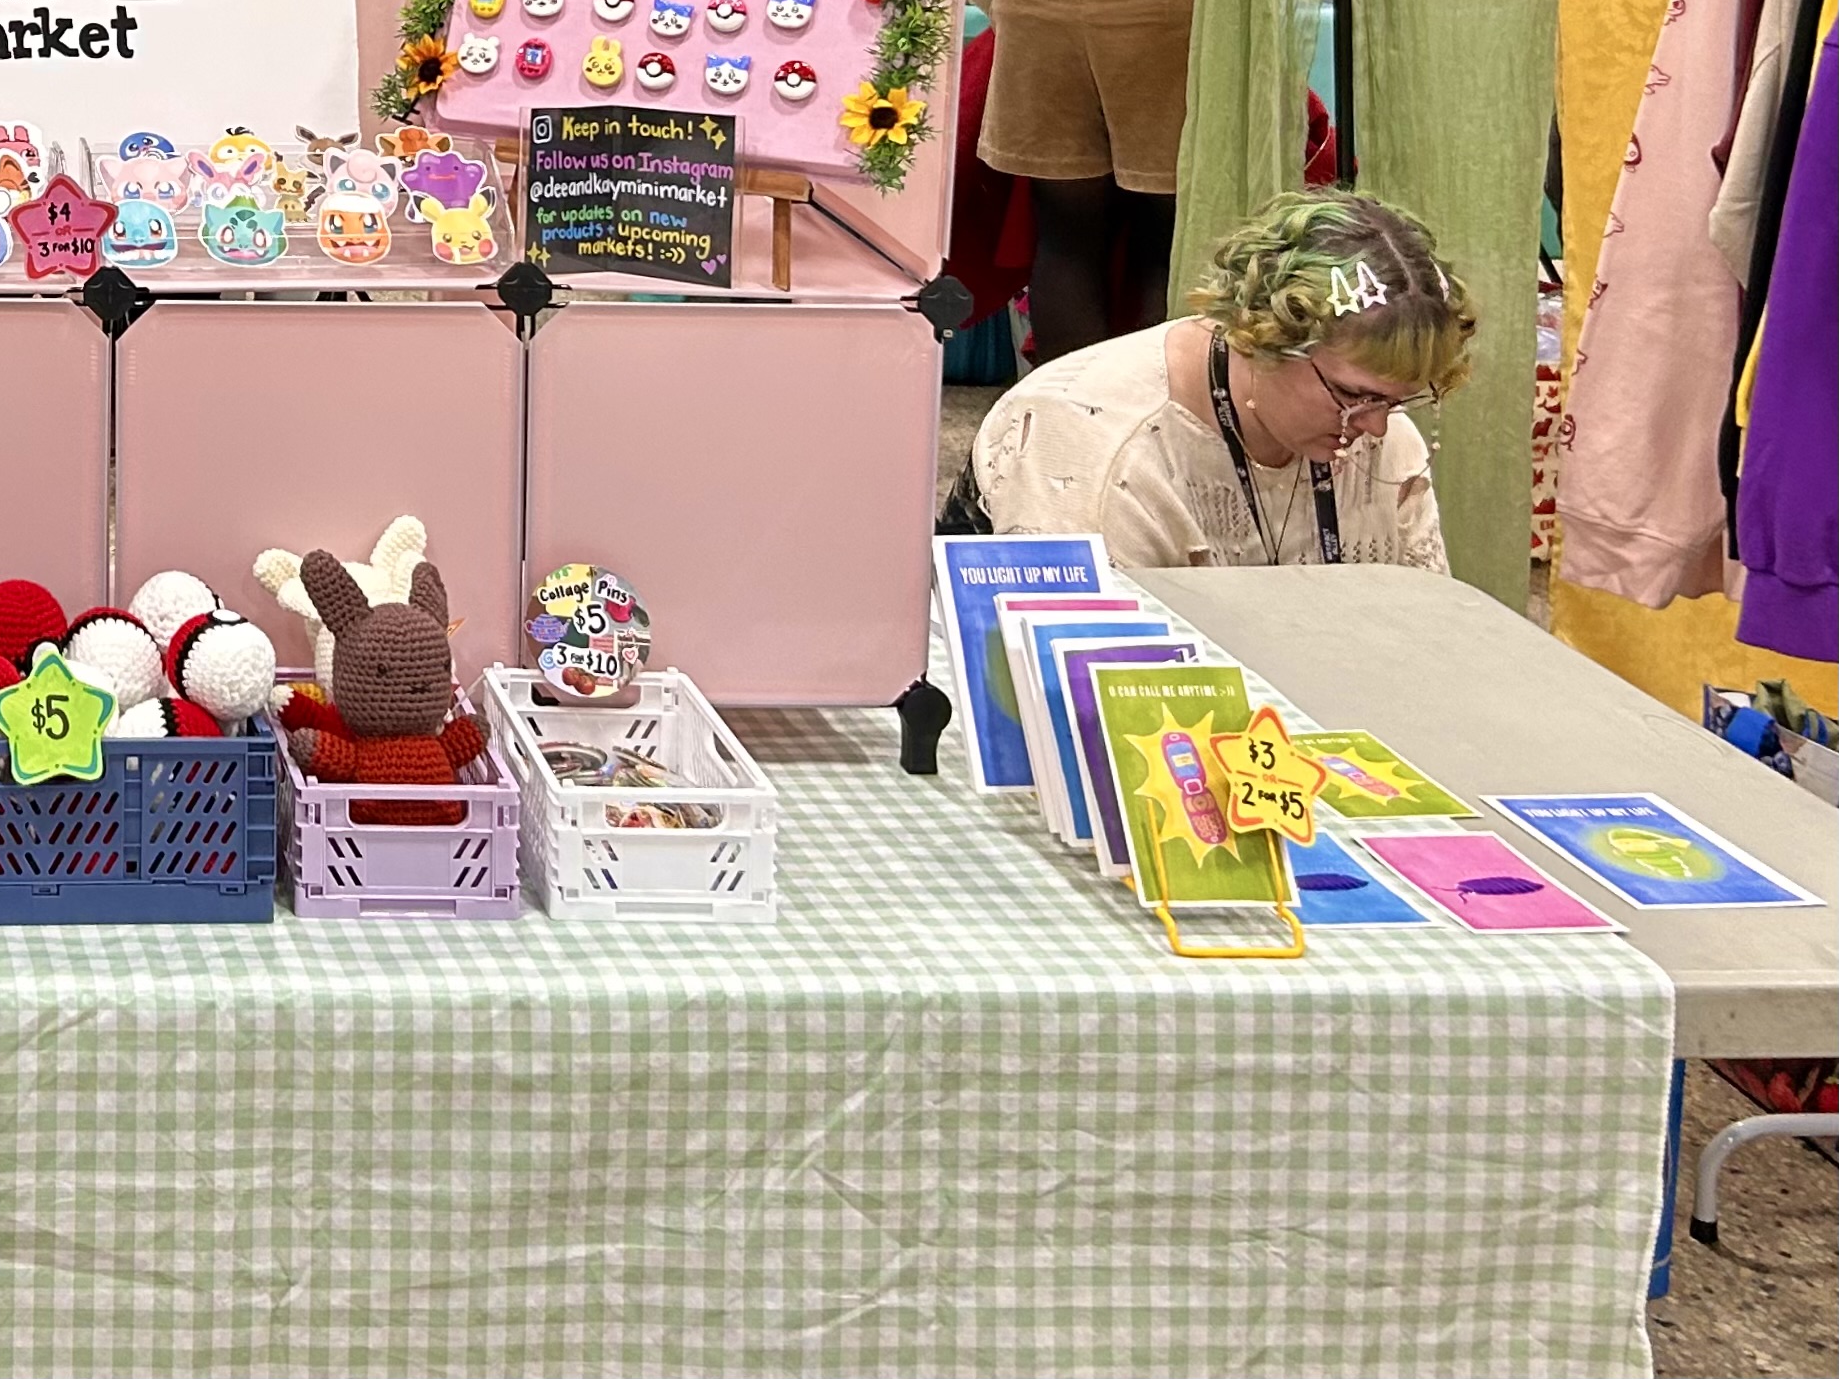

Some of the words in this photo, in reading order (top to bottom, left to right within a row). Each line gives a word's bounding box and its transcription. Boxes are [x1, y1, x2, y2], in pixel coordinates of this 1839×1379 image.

[561, 116, 600, 142] Keep
[604, 118, 621, 135] in
[628, 114, 693, 141] touch!
[535, 150, 587, 171] Follow
[590, 153, 609, 170] us
[612, 156, 636, 171] on
[637, 152, 734, 186] Instagram
[530, 172, 728, 209] @deeandkayminimarket
[47, 202, 71, 226] $4
[535, 206, 557, 225] for
[561, 205, 614, 231] updates
[621, 208, 643, 222] on
[649, 209, 687, 228] new
[37, 241, 50, 258] 3
[52, 242, 71, 253] FOR
[71, 237, 96, 257] $10
[541, 222, 604, 245] products
[617, 222, 712, 261] upcoming
[578, 238, 654, 261] markets!
[959, 567, 986, 585] YOU
[987, 567, 1023, 585] LIGHT
[1023, 566, 1041, 584] UP
[1041, 566, 1062, 583] MY
[1063, 566, 1088, 583] LIFE
[539, 581, 590, 603] Collage
[597, 580, 629, 604] Pins
[574, 604, 607, 635] $5
[556, 645, 567, 665] 3
[586, 650, 618, 676] $10
[1118, 685, 1137, 698] CAN
[1138, 685, 1161, 698] CALL
[1162, 685, 1176, 697] ME
[1177, 684, 1217, 698] ANYTIME
[30, 693, 70, 741] $5
[1248, 737, 1276, 770] $3
[1241, 782, 1256, 807] 2
[1258, 789, 1278, 804] FOR
[1279, 790, 1305, 820] $5
